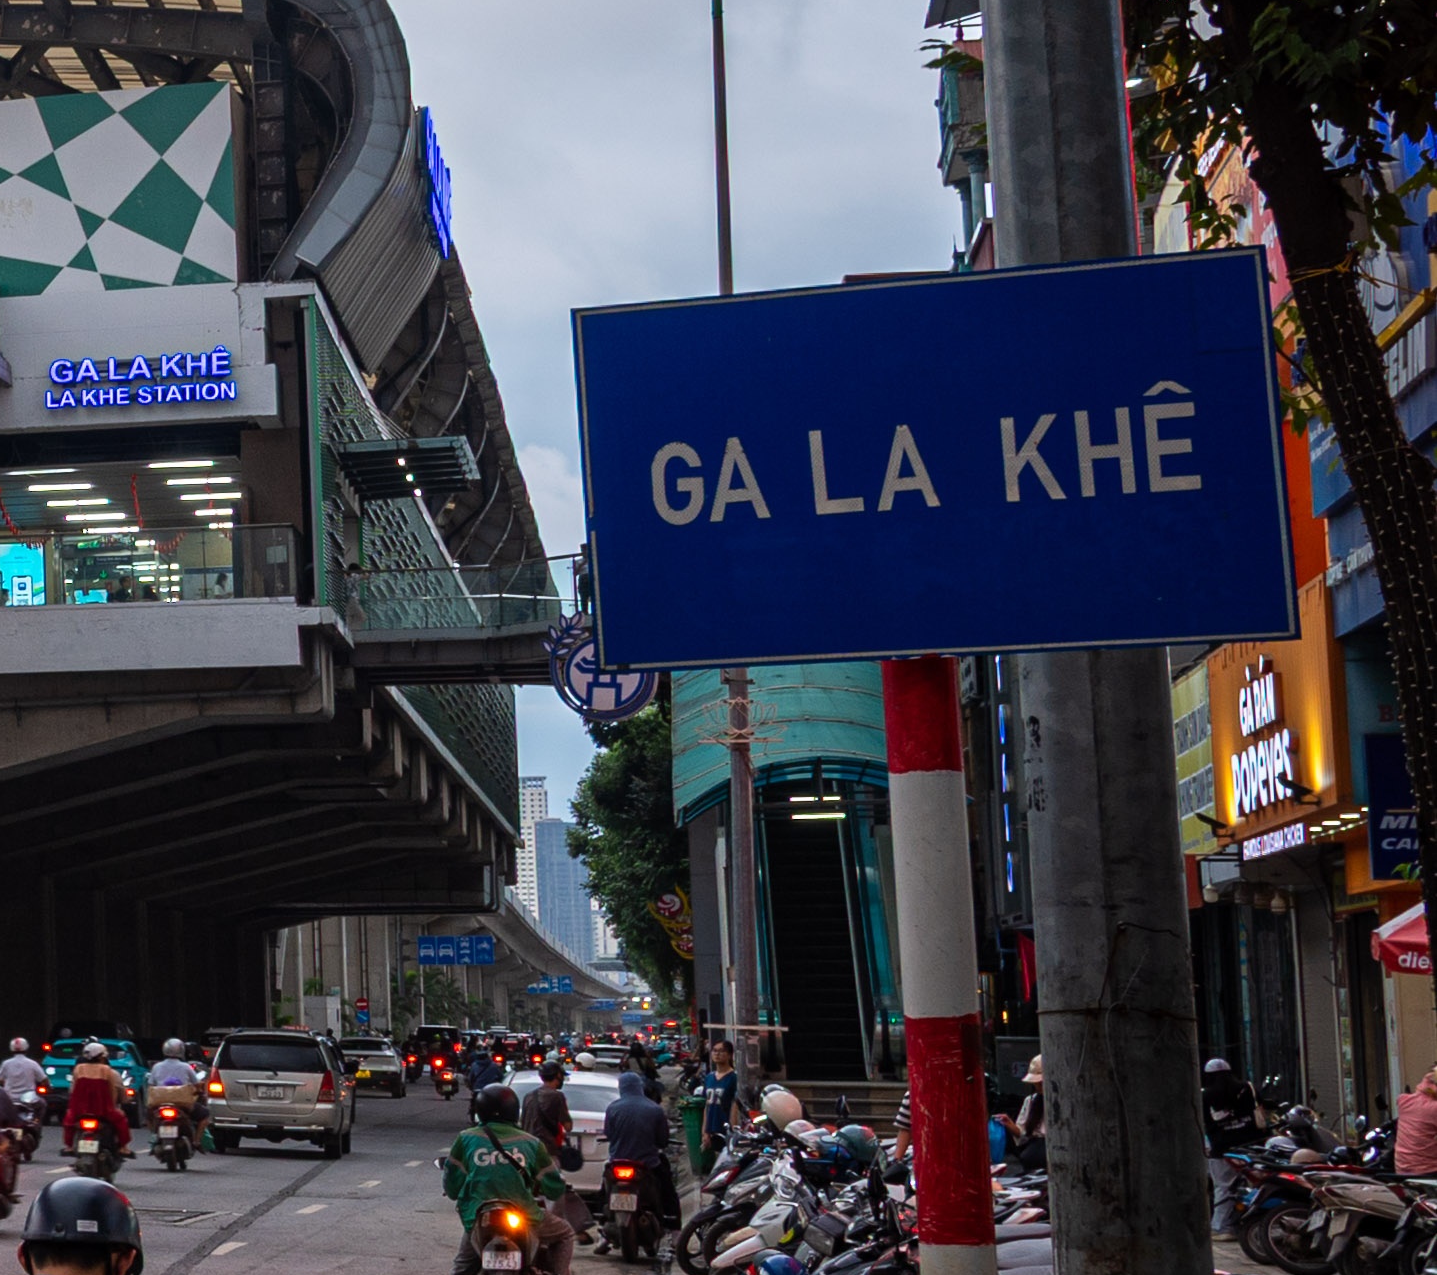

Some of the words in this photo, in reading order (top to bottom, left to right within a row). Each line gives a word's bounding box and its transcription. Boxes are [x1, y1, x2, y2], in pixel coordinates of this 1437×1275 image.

[49, 358, 100, 384] GA
[107, 355, 153, 381] LA
[161, 345, 232, 378] KHÊ
[45, 390, 77, 409] LA
[81, 387, 131, 407] KHE
[137, 381, 237, 405] STATION
[649, 436, 771, 526] GA
[808, 423, 941, 515] LA
[998, 380, 1203, 504] KHÊ
